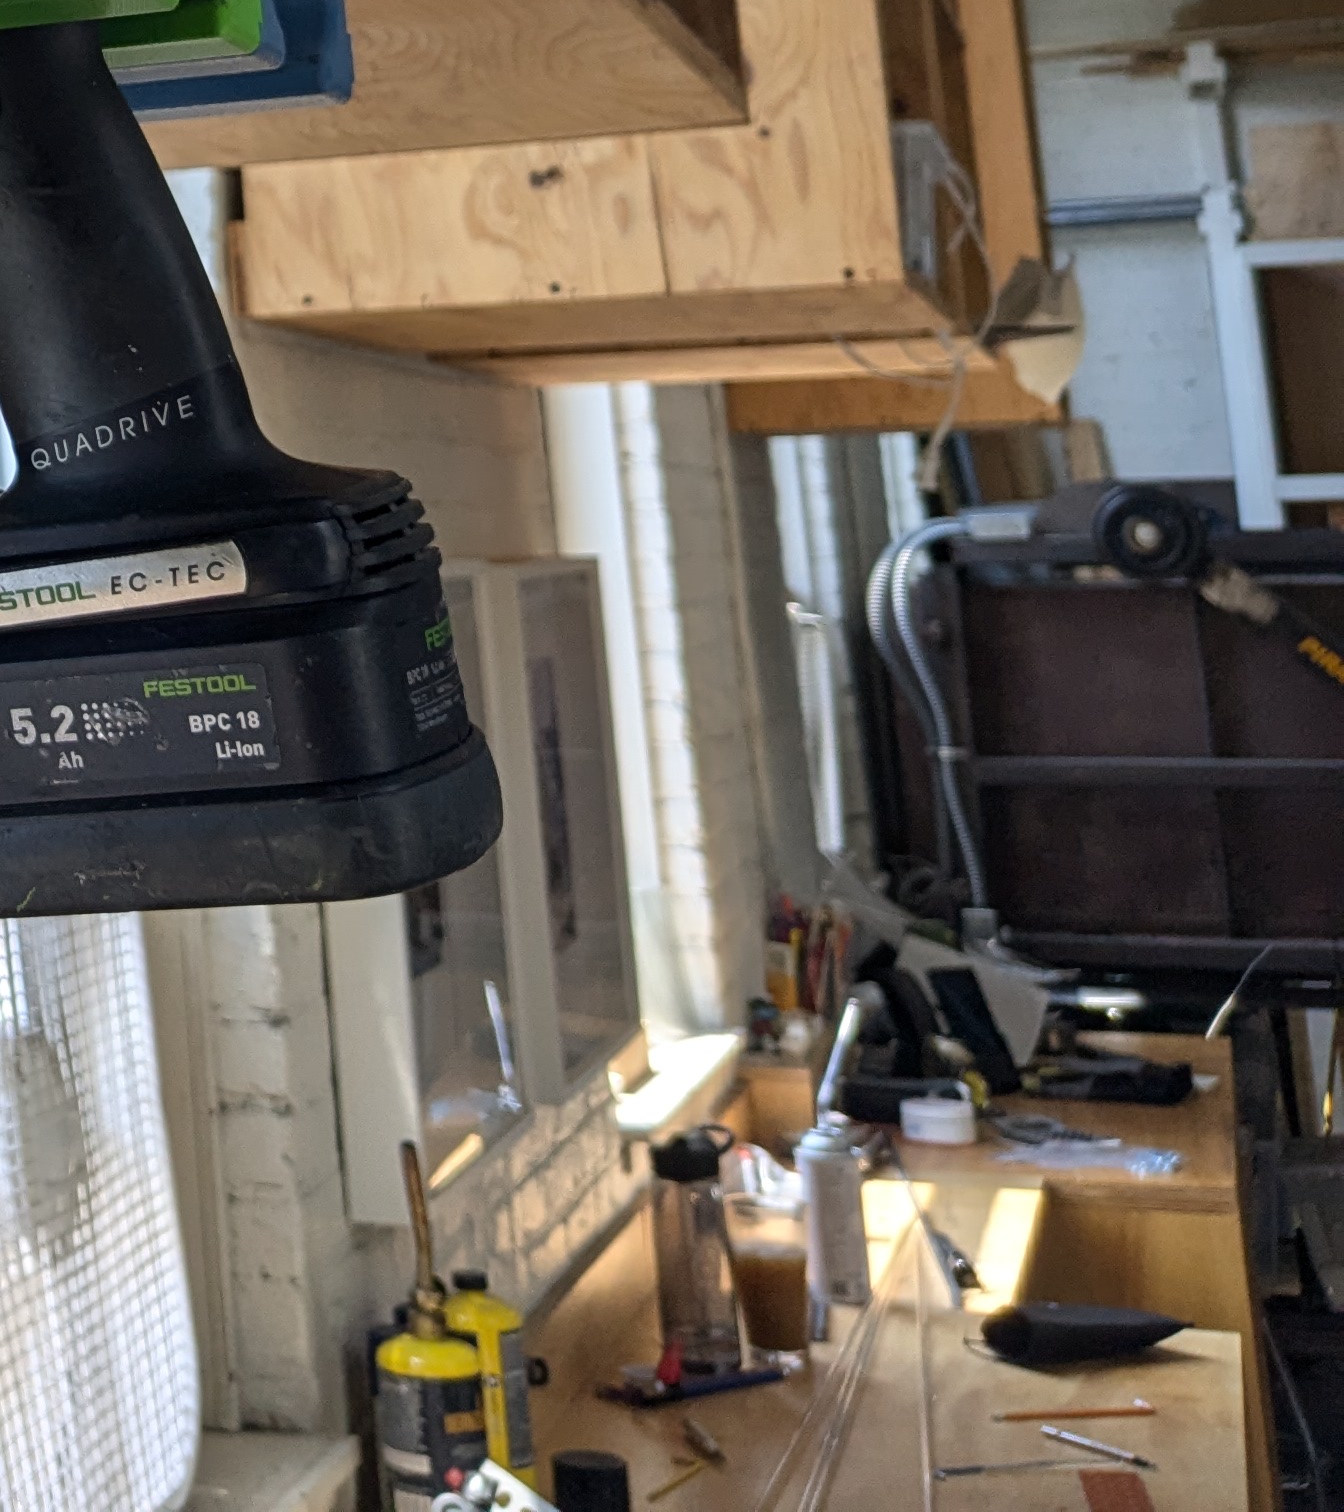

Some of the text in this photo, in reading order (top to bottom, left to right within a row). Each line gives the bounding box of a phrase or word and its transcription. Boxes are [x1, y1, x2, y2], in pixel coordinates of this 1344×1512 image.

[30, 394, 196, 471] QUADRIVE
[110, 560, 226, 595] EC-TEC
[142, 674, 257, 698] FESTOOL
[10, 704, 79, 746] 5.2
[188, 710, 261, 734] BPC 18
[58, 751, 85, 769] Ah
[215, 740, 265, 759] Li-Ion
